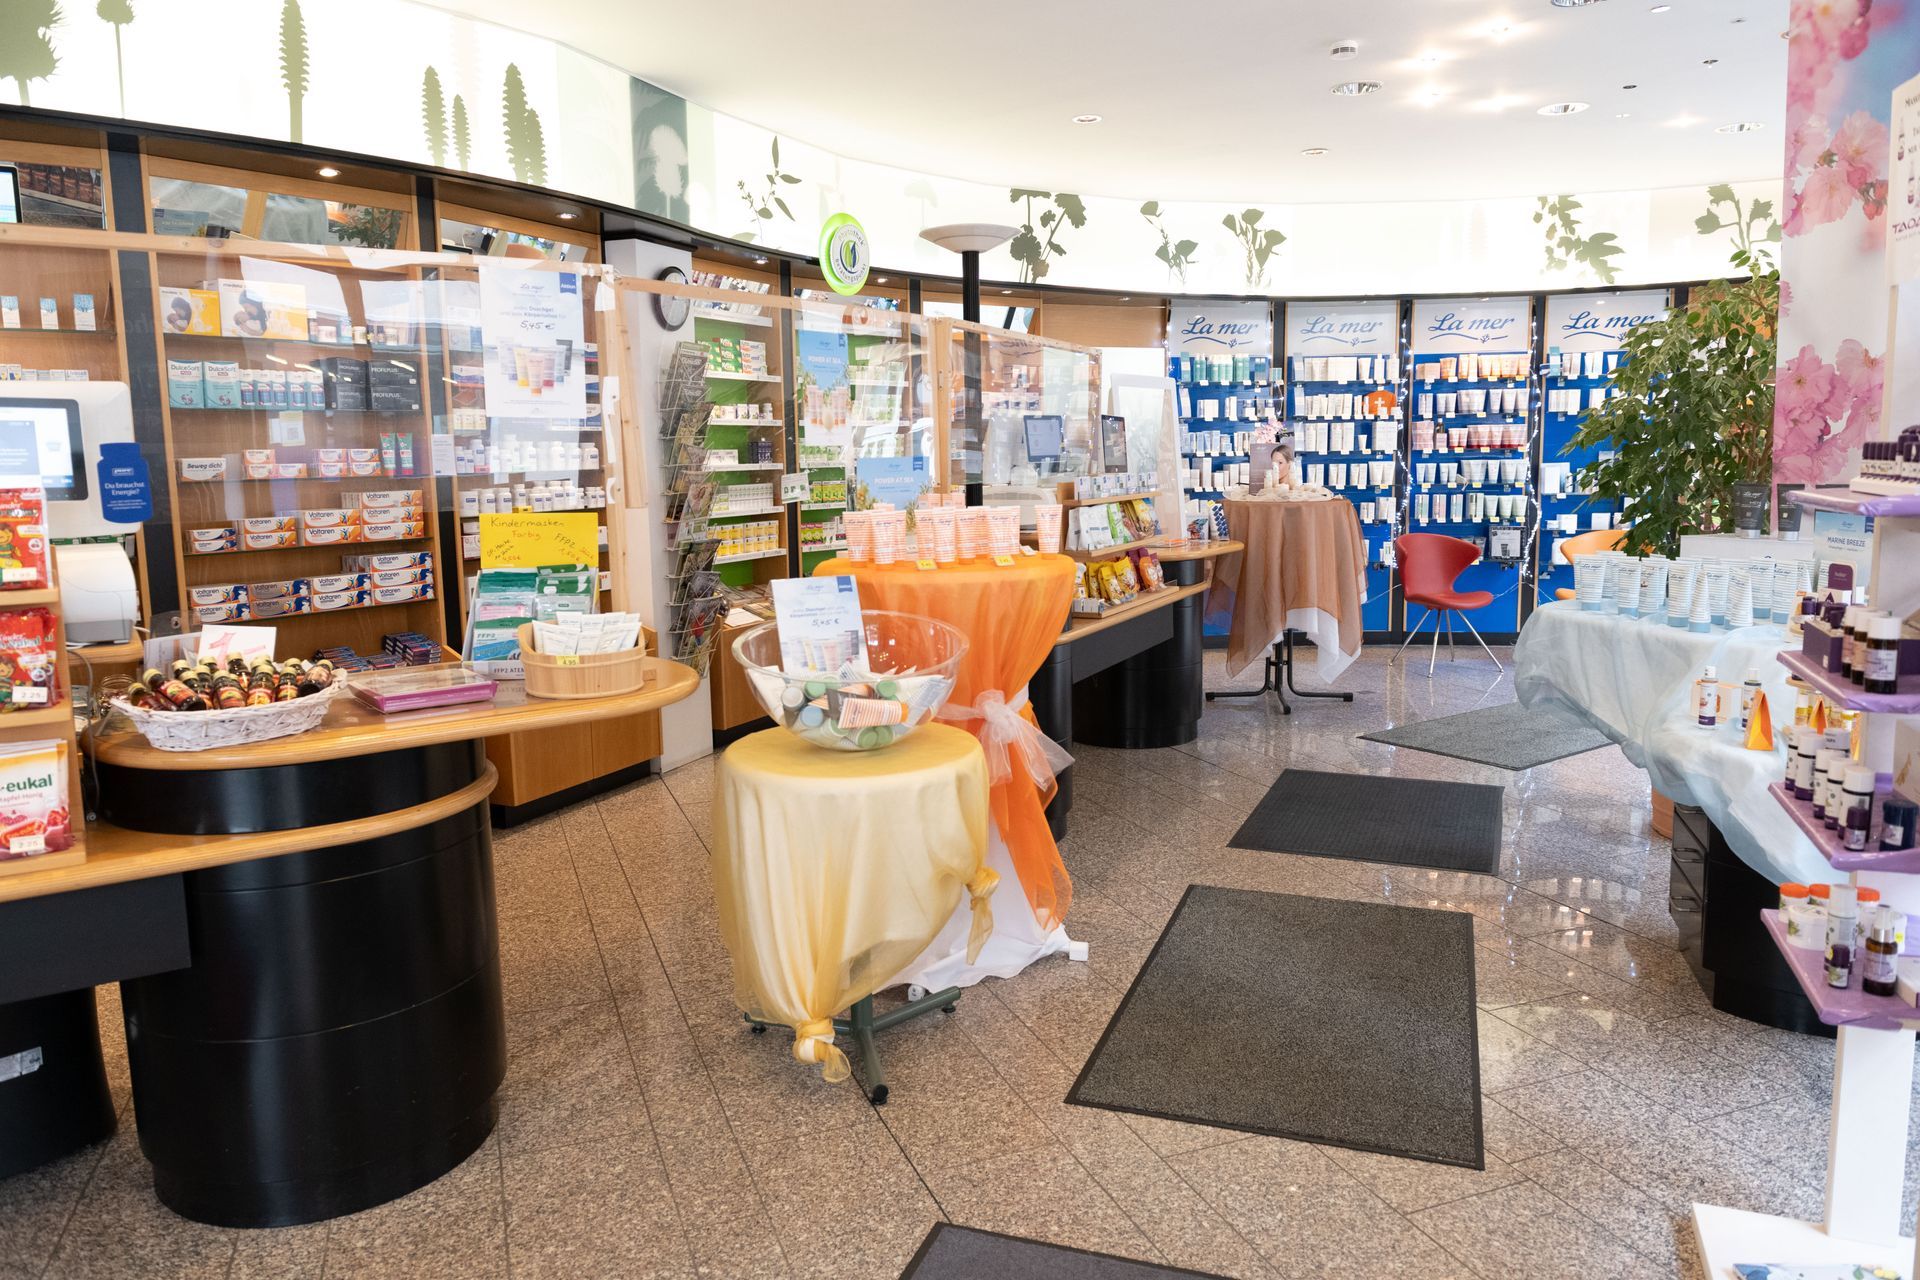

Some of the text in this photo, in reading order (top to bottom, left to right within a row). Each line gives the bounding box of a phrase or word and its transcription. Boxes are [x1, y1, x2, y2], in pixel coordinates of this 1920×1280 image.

[1182, 316, 1259, 335] La mer
[1300, 316, 1383, 334] La mer
[1428, 313, 1515, 332] La mer
[1562, 311, 1655, 330] La mer
[112, 488, 140, 496] Energie?
[555, 532, 576, 549] FFP2
[1828, 536, 1866, 548] MARINE BREEZE
